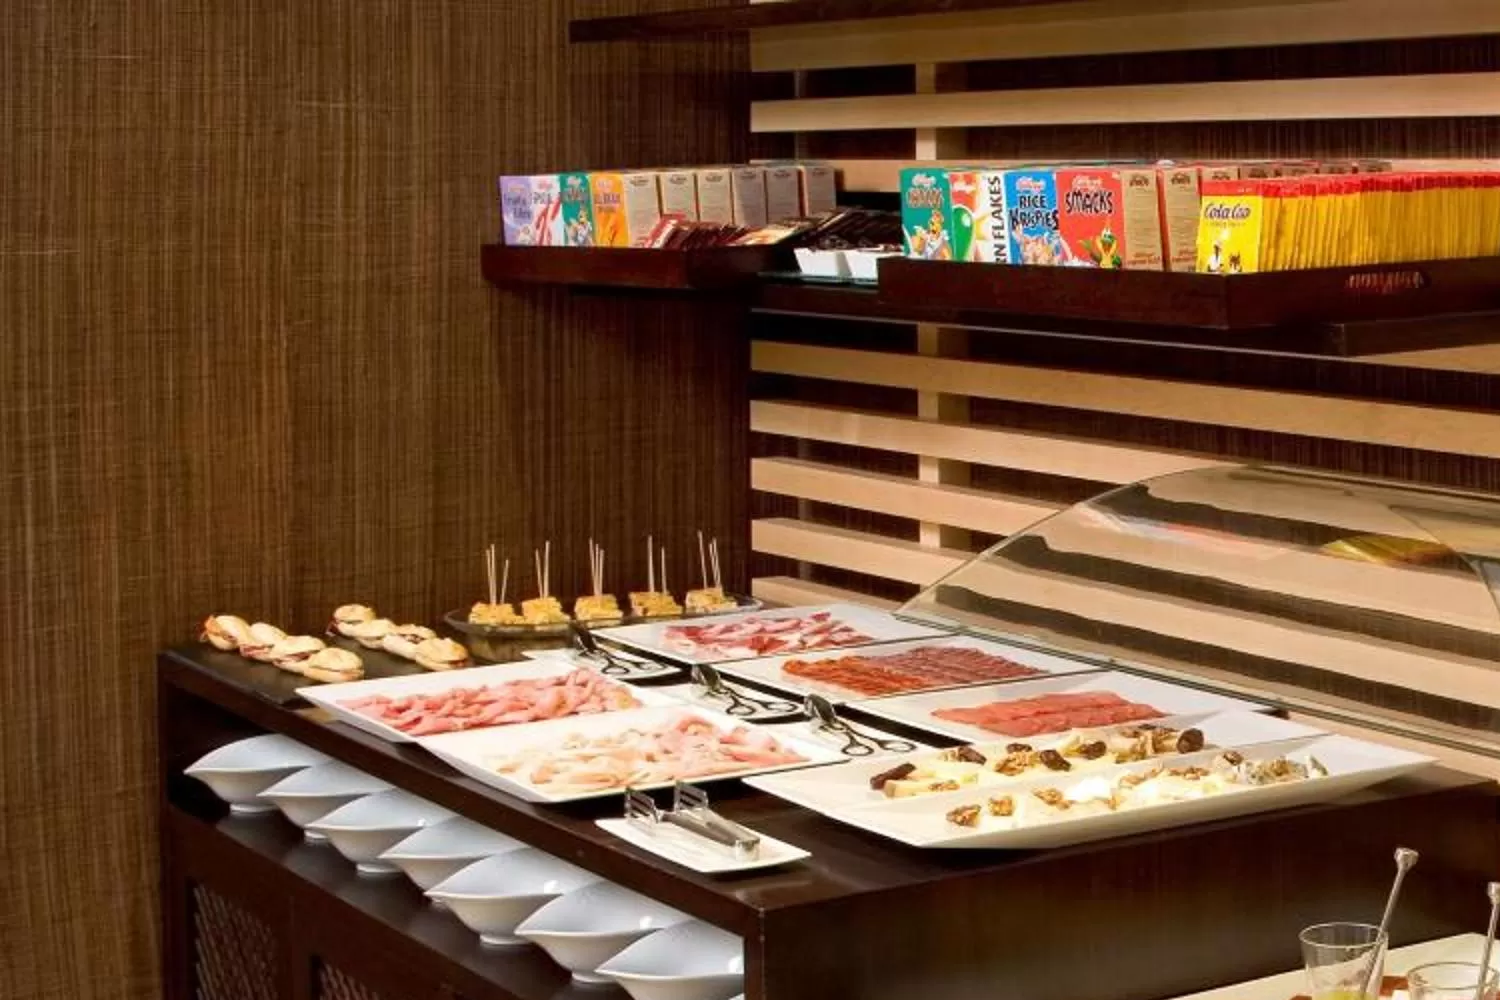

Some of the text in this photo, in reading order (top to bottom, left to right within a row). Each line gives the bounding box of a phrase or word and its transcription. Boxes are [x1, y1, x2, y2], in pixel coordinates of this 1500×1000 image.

[988, 175, 1005, 240] FLAKES
[1019, 195, 1047, 209] RICE
[1065, 189, 1114, 214] SMACKS
[1204, 203, 1251, 220] Cola Cao
[1009, 208, 1060, 231] KRISPIES
